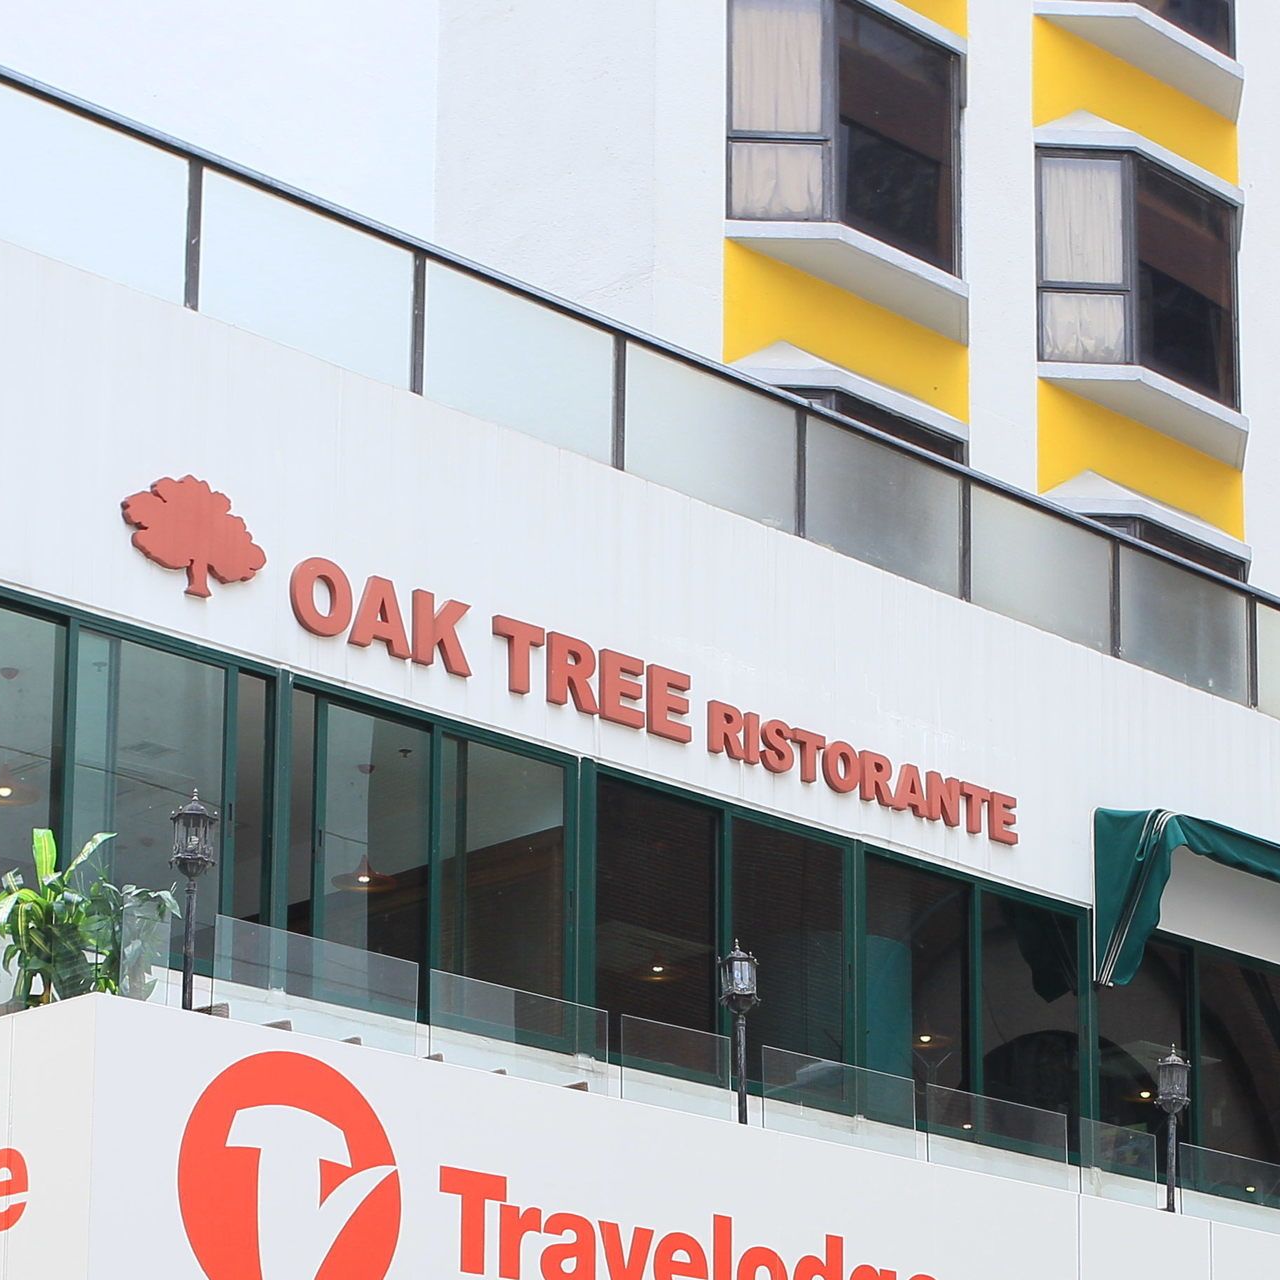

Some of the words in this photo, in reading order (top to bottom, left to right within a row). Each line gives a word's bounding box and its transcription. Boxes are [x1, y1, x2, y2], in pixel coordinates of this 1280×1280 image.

[290, 557, 472, 678] OAK
[492, 614, 693, 744] TREE
[707, 700, 1019, 846] RISTORANTE
